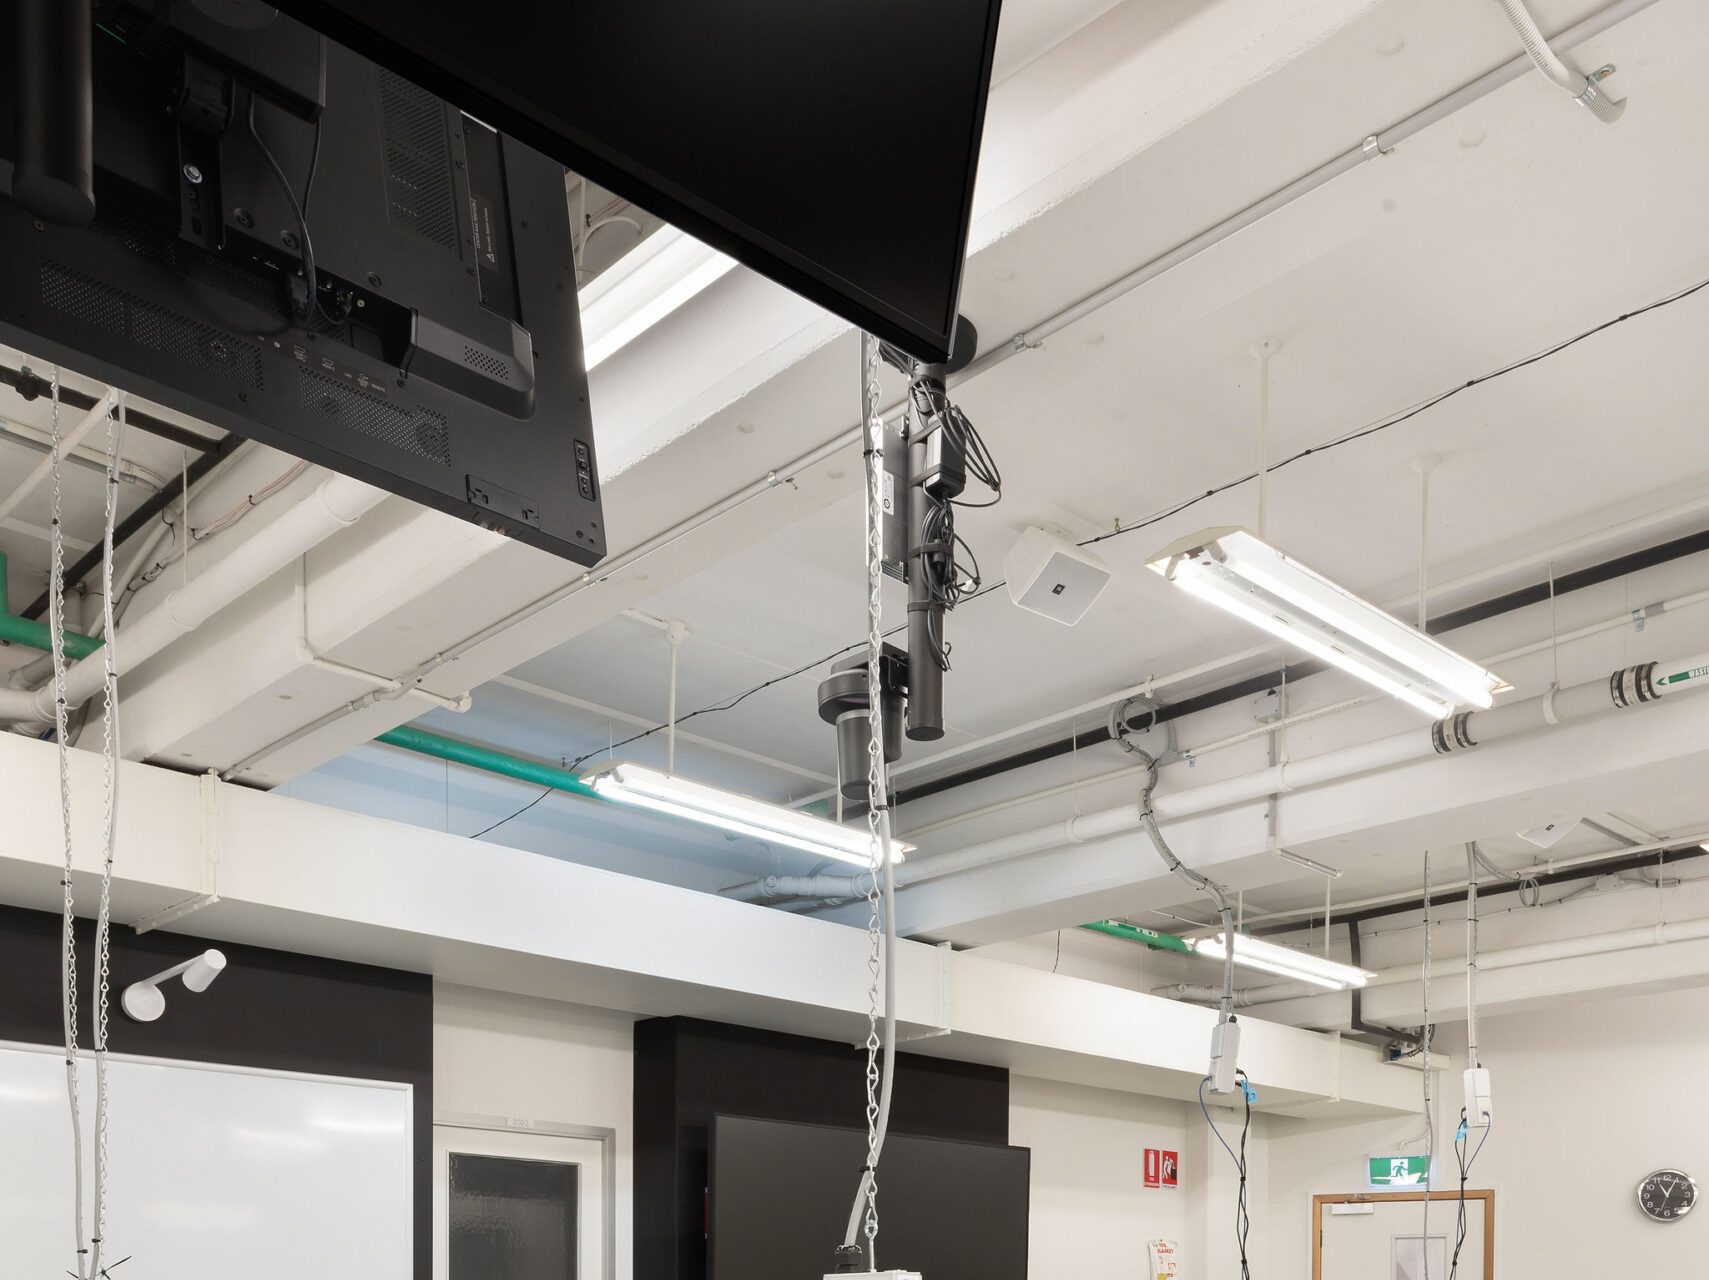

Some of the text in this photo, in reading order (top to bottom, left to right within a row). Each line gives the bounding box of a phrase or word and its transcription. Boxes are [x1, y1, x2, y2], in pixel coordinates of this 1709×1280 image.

[1681, 1182, 1688, 1190] 2
[1653, 1207, 1660, 1215] 7
[1663, 1209, 1671, 1217] 6
